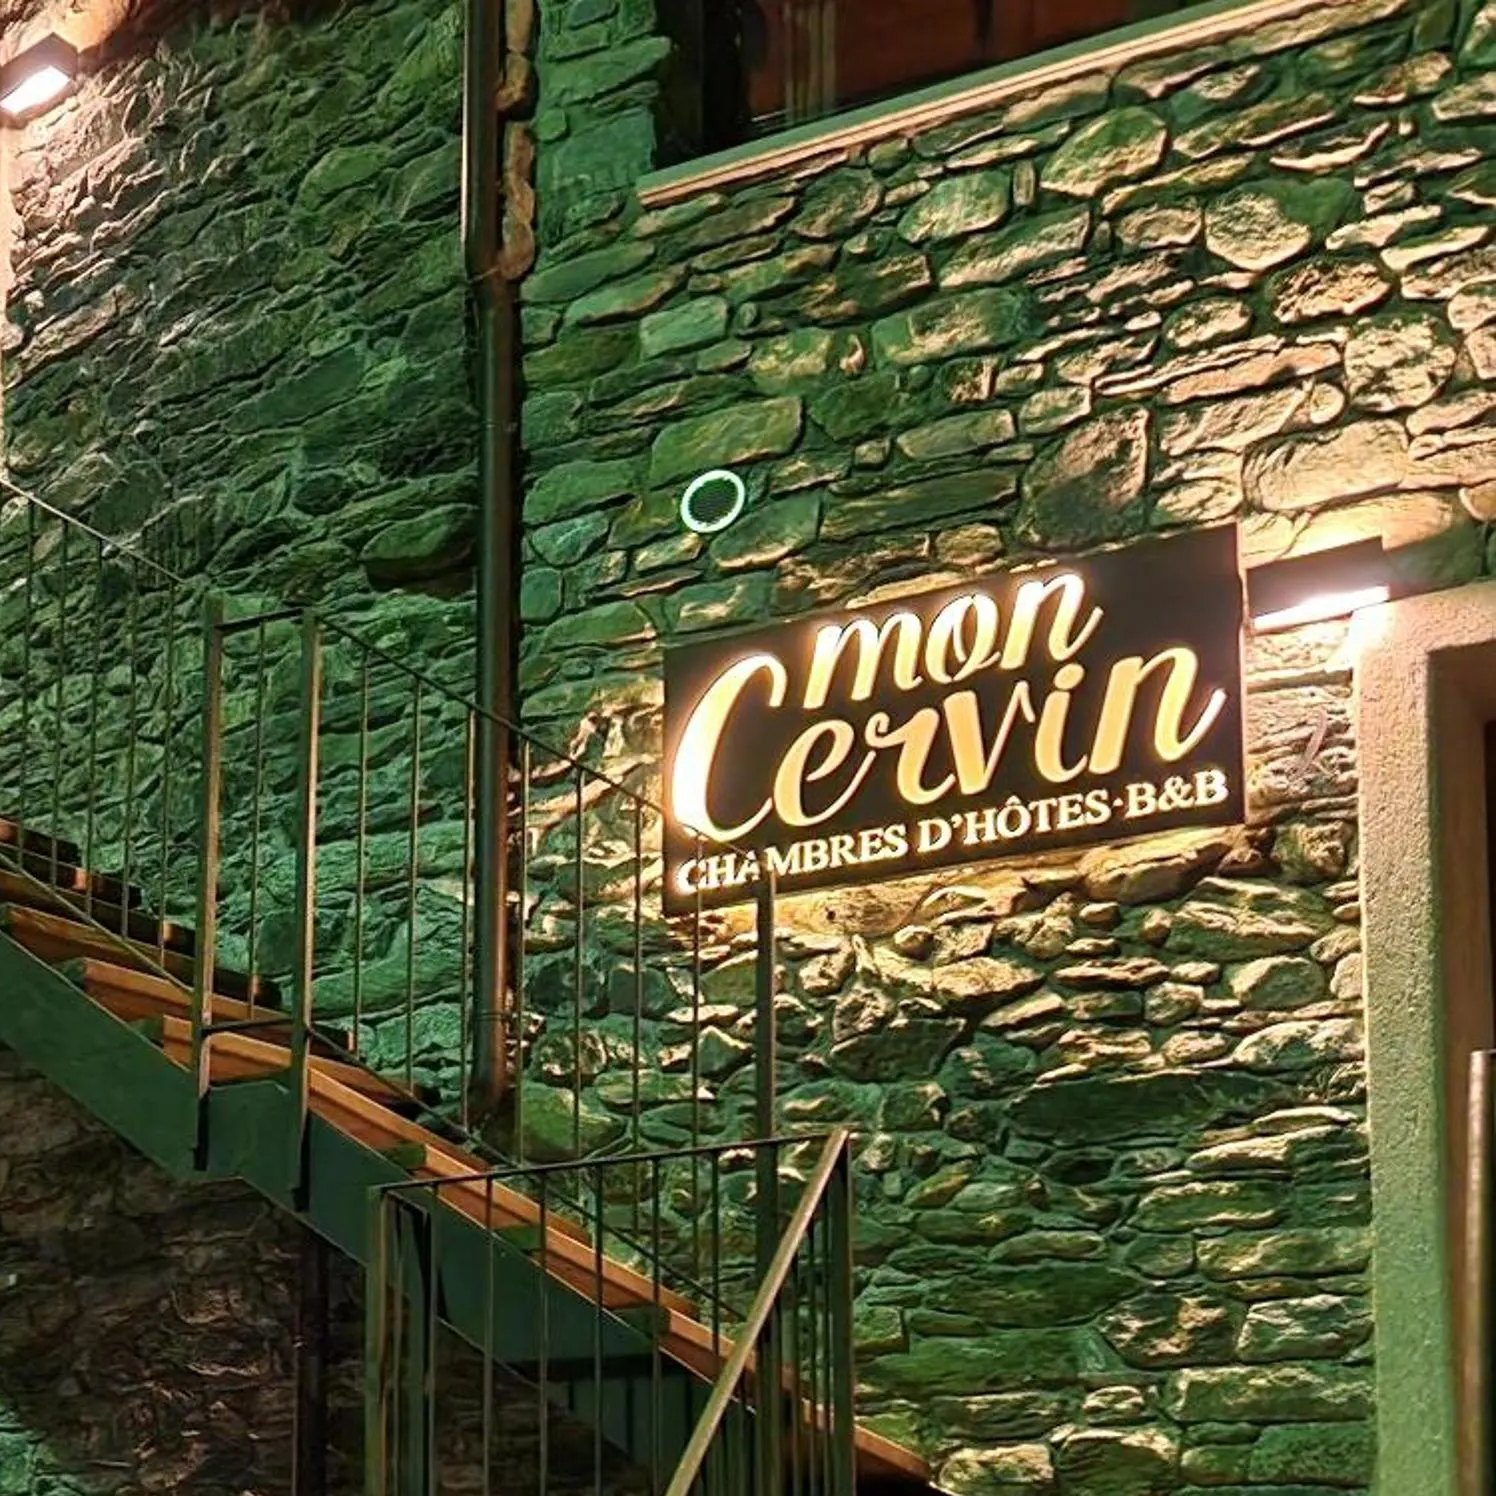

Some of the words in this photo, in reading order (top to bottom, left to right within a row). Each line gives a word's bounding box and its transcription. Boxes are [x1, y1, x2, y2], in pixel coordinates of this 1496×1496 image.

[803, 573, 1104, 708] mon
[671, 647, 1228, 842] Cervin
[675, 824, 909, 896] CHAMBRES
